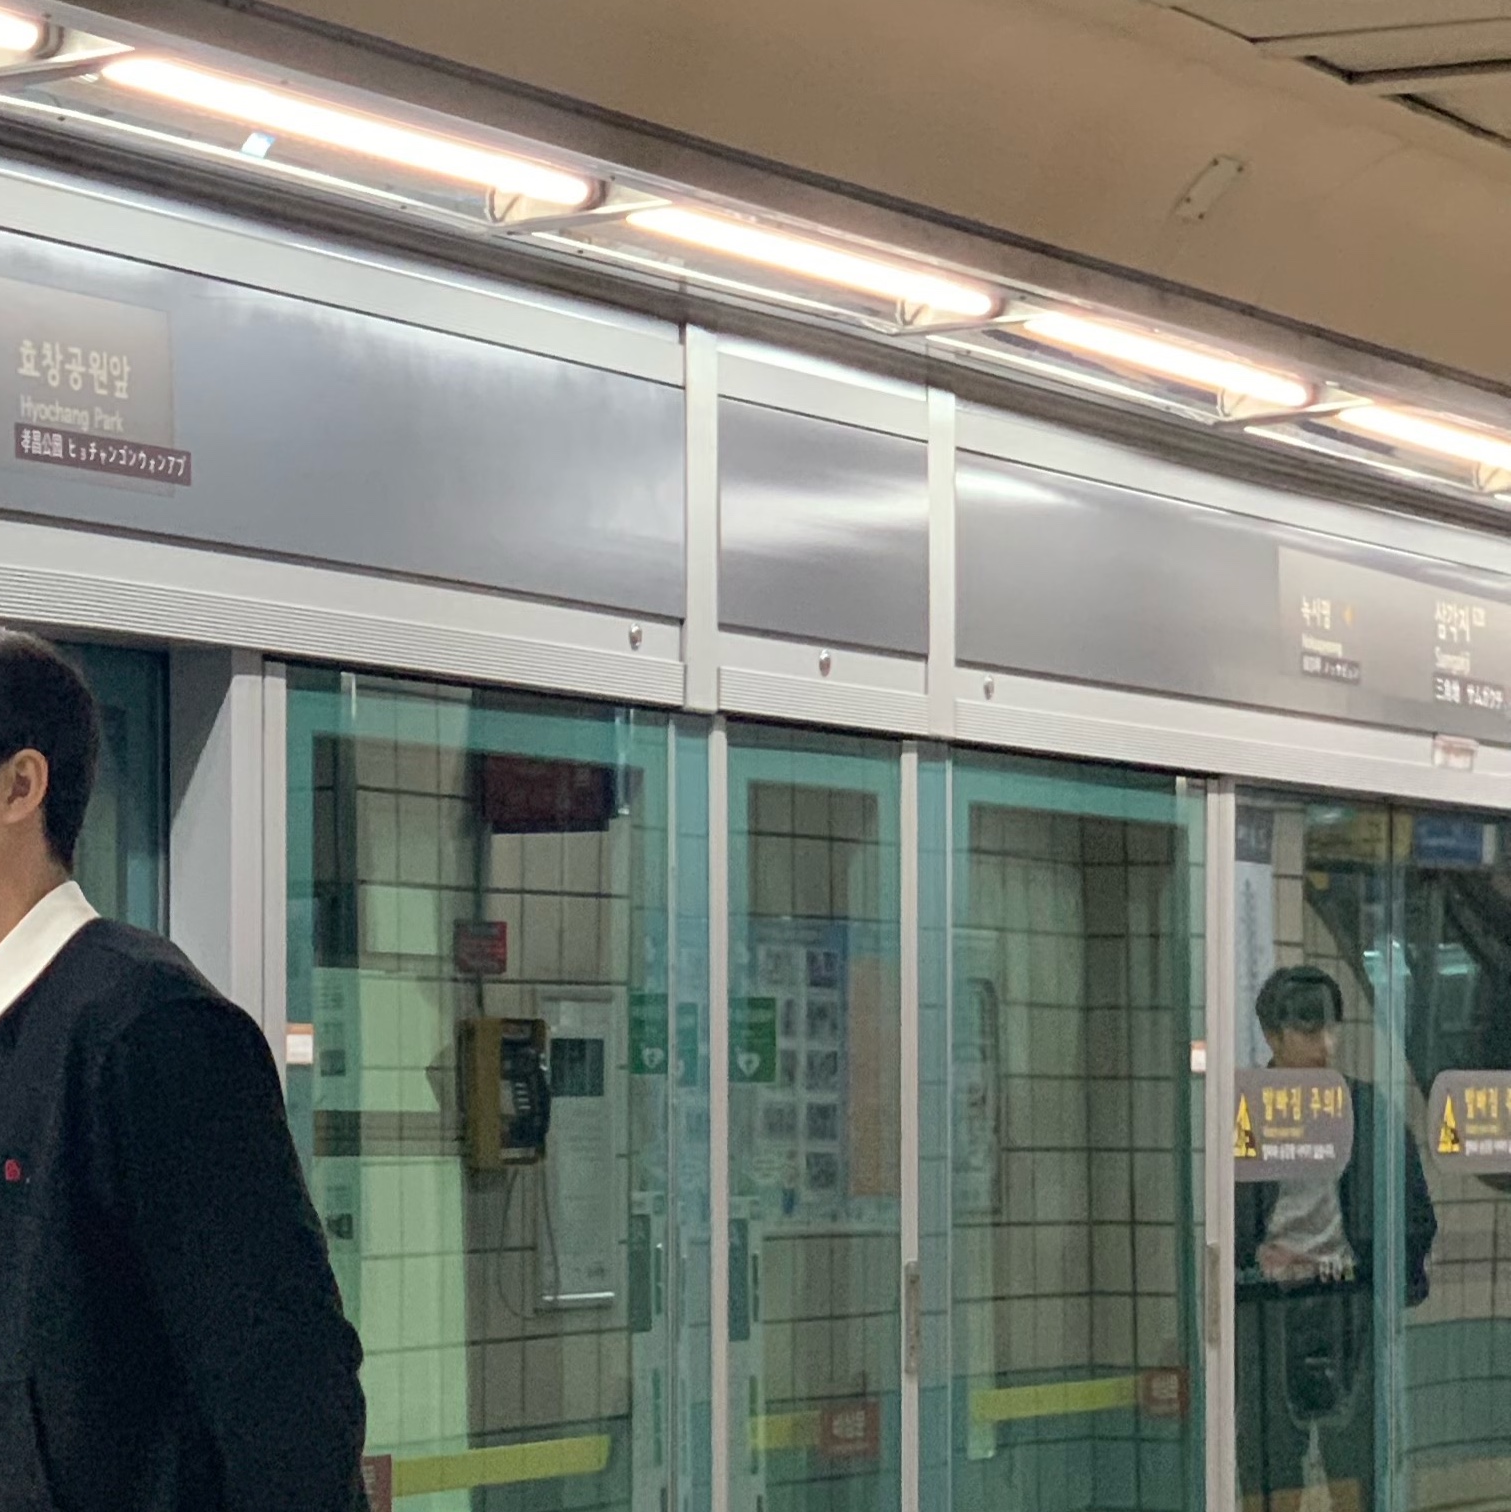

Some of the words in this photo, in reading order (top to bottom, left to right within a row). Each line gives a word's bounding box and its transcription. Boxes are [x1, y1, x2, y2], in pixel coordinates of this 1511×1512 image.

[16, 339, 132, 400] 효창공원앞
[19, 393, 90, 432] Hyochang
[94, 406, 125, 434] Park
